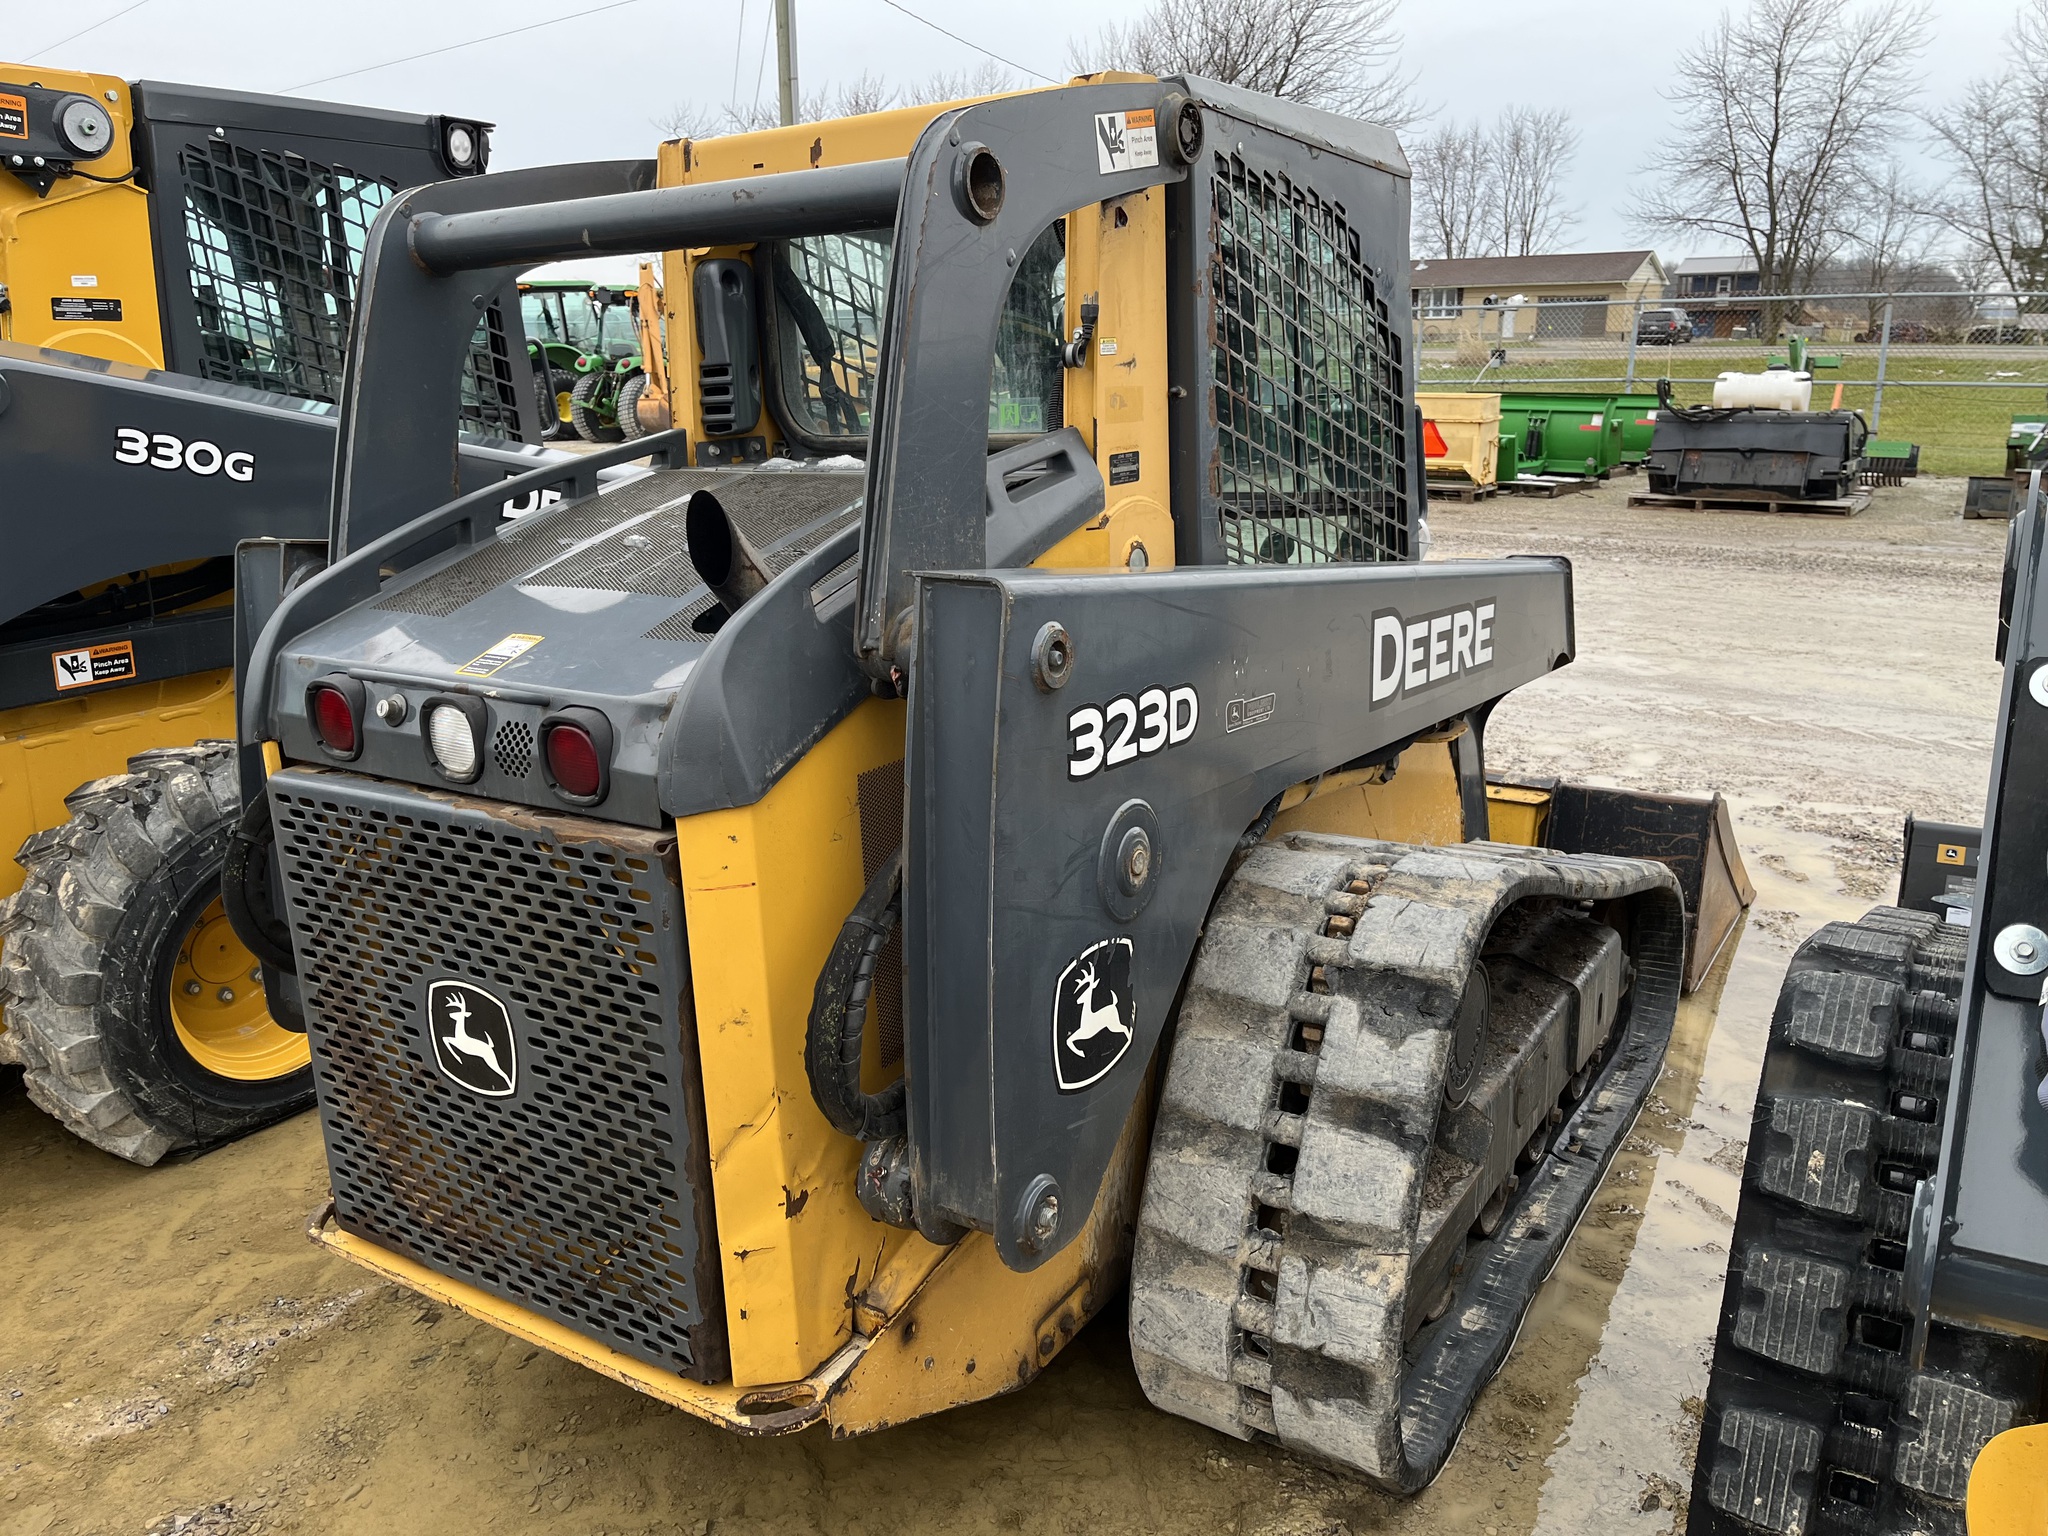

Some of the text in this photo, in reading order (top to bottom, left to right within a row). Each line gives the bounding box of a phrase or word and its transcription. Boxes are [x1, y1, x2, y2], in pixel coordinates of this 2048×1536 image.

[0, 99, 22, 107] RNING
[4, 113, 22, 123] Area
[1131, 114, 1153, 124] WARNING
[1131, 135, 1153, 144] Pinch Area
[114, 427, 255, 482] 330G
[98, 644, 129, 655] WARNING
[1372, 603, 1495, 702] DEERE
[93, 658, 129, 669] Pinch Area
[1069, 686, 1199, 777] 323D
